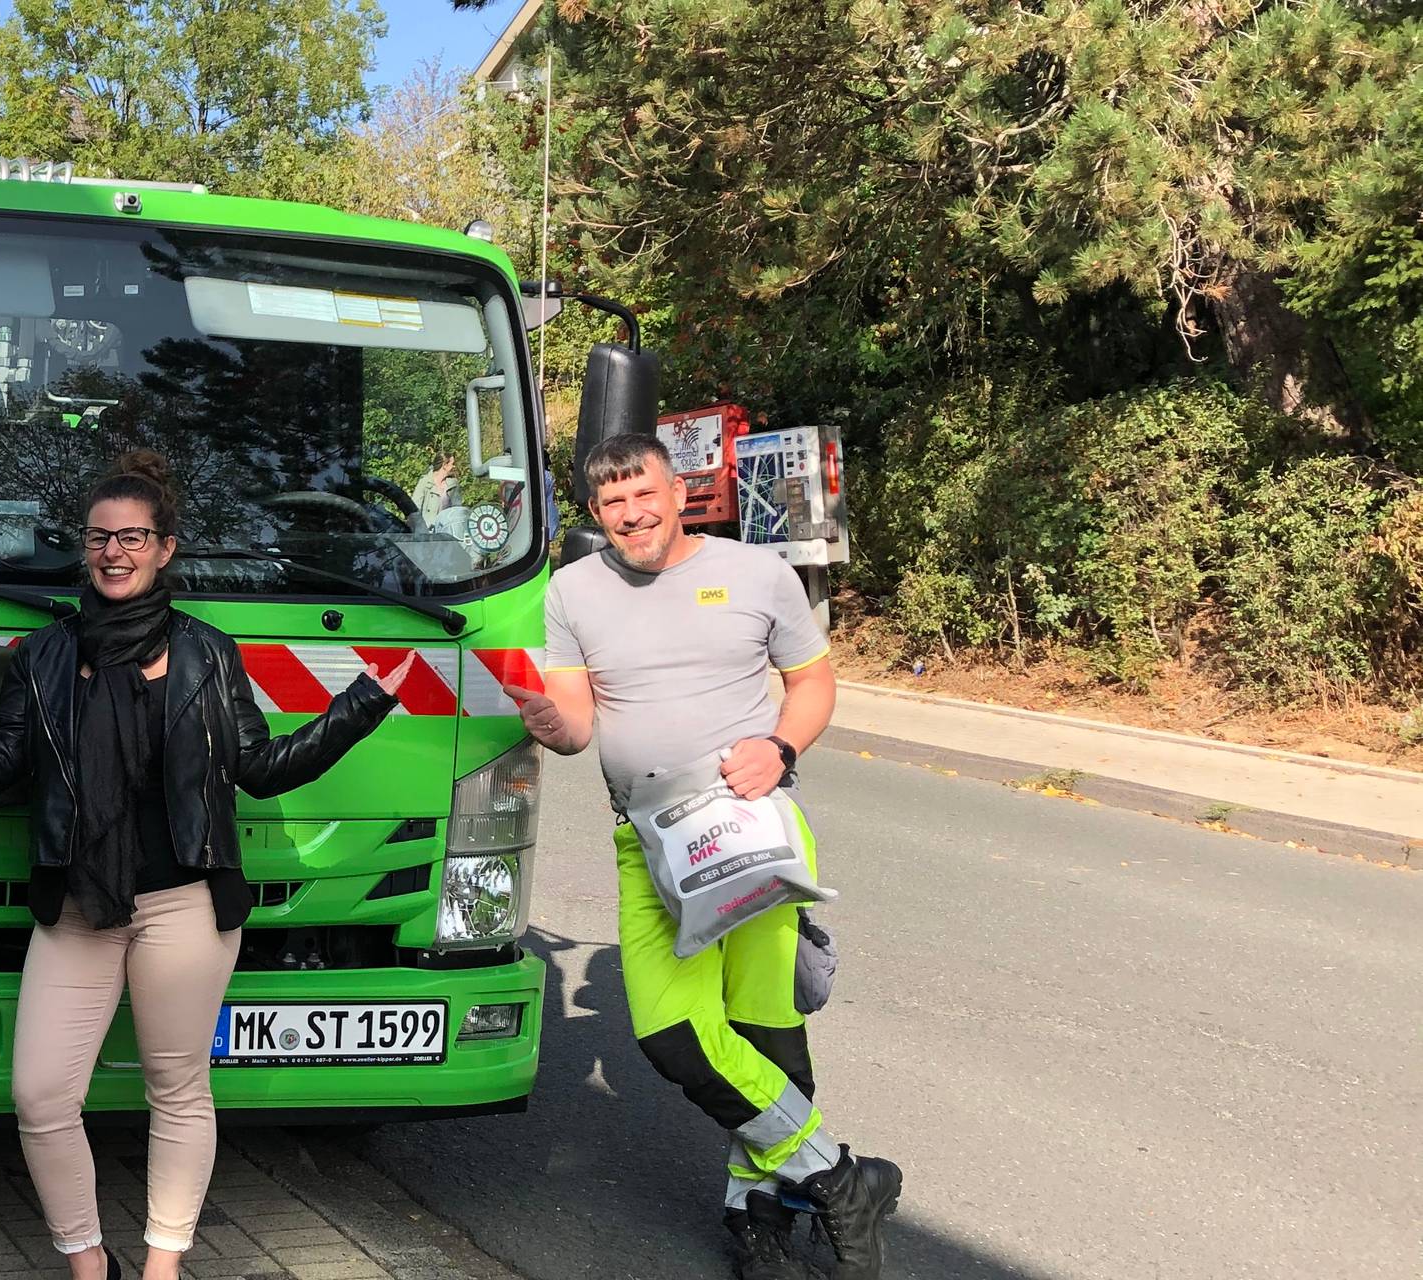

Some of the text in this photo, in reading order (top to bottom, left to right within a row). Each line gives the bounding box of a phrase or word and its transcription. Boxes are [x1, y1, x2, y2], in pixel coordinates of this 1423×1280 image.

[701, 589, 724, 600] DMS
[668, 807, 684, 821] DIE
[686, 820, 742, 856] RADIO
[688, 840, 722, 866] MK
[699, 851, 775, 882] DER BESTE MIX.
[214, 1036, 223, 1048] D
[234, 1010, 441, 1050] MK ST 1599
